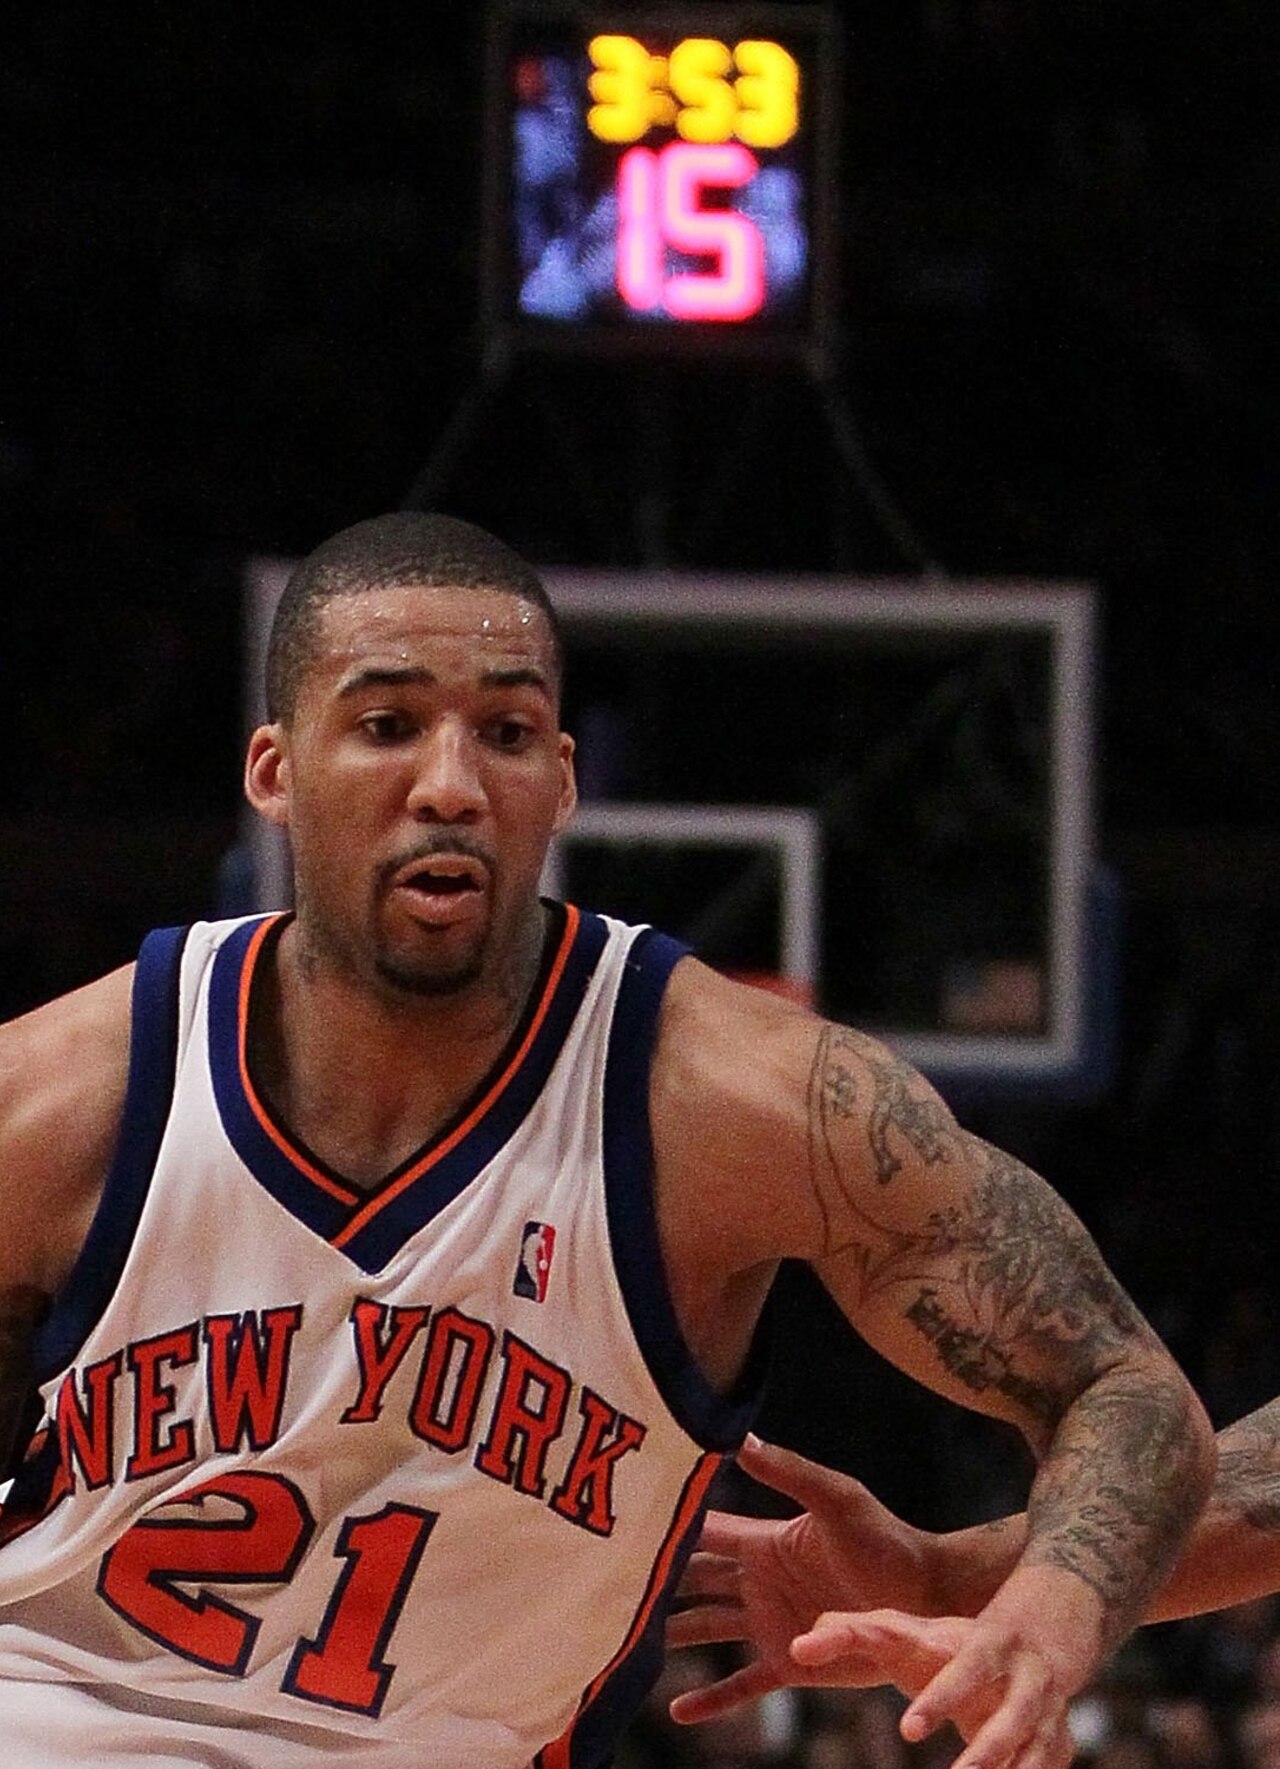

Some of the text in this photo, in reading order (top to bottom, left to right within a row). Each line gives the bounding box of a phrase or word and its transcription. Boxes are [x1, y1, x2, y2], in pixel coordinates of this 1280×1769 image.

[587, 35, 800, 148] 3:53
[618, 142, 767, 321] 15
[50, 1296, 647, 1537] NEW YORK
[96, 1469, 440, 1719] 21
